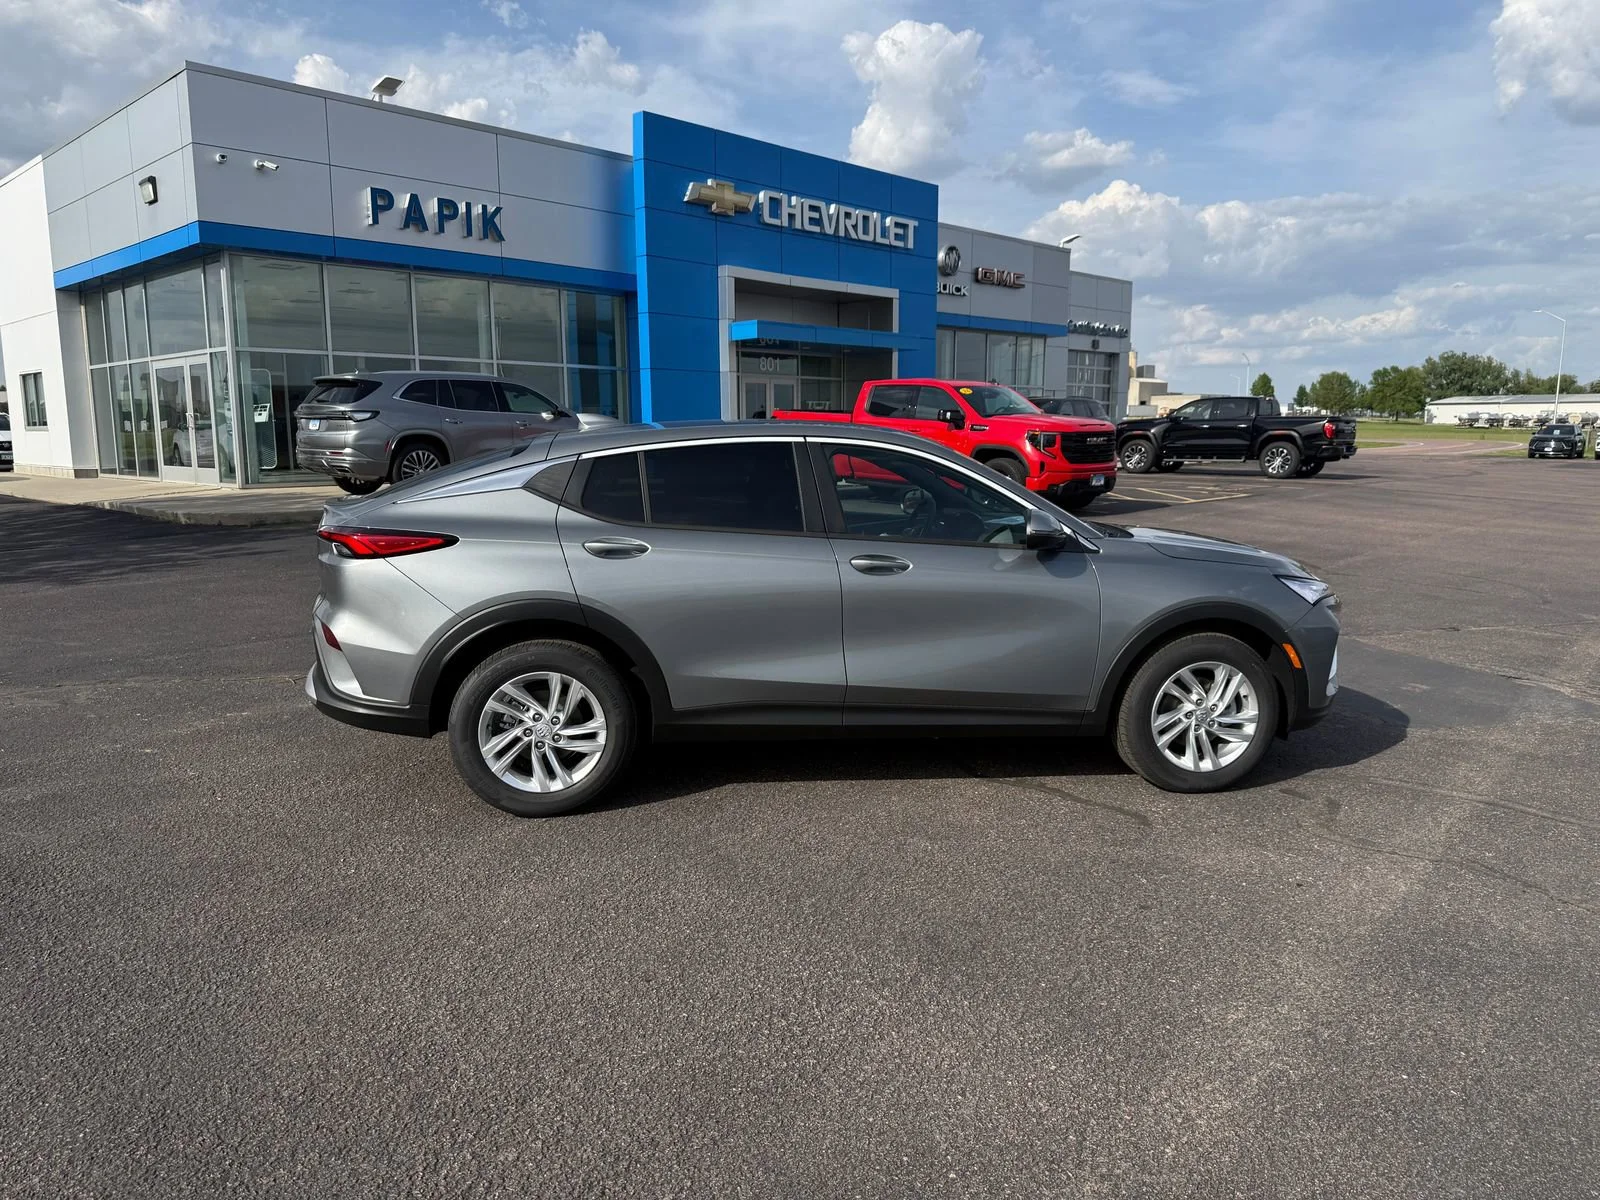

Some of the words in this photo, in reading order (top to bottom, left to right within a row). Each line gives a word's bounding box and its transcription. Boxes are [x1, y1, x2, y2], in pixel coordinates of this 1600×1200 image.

[367, 186, 505, 242] PAPIK
[758, 189, 918, 249] CHEVROLET
[977, 267, 1024, 288] GMC
[760, 357, 780, 372] 801
